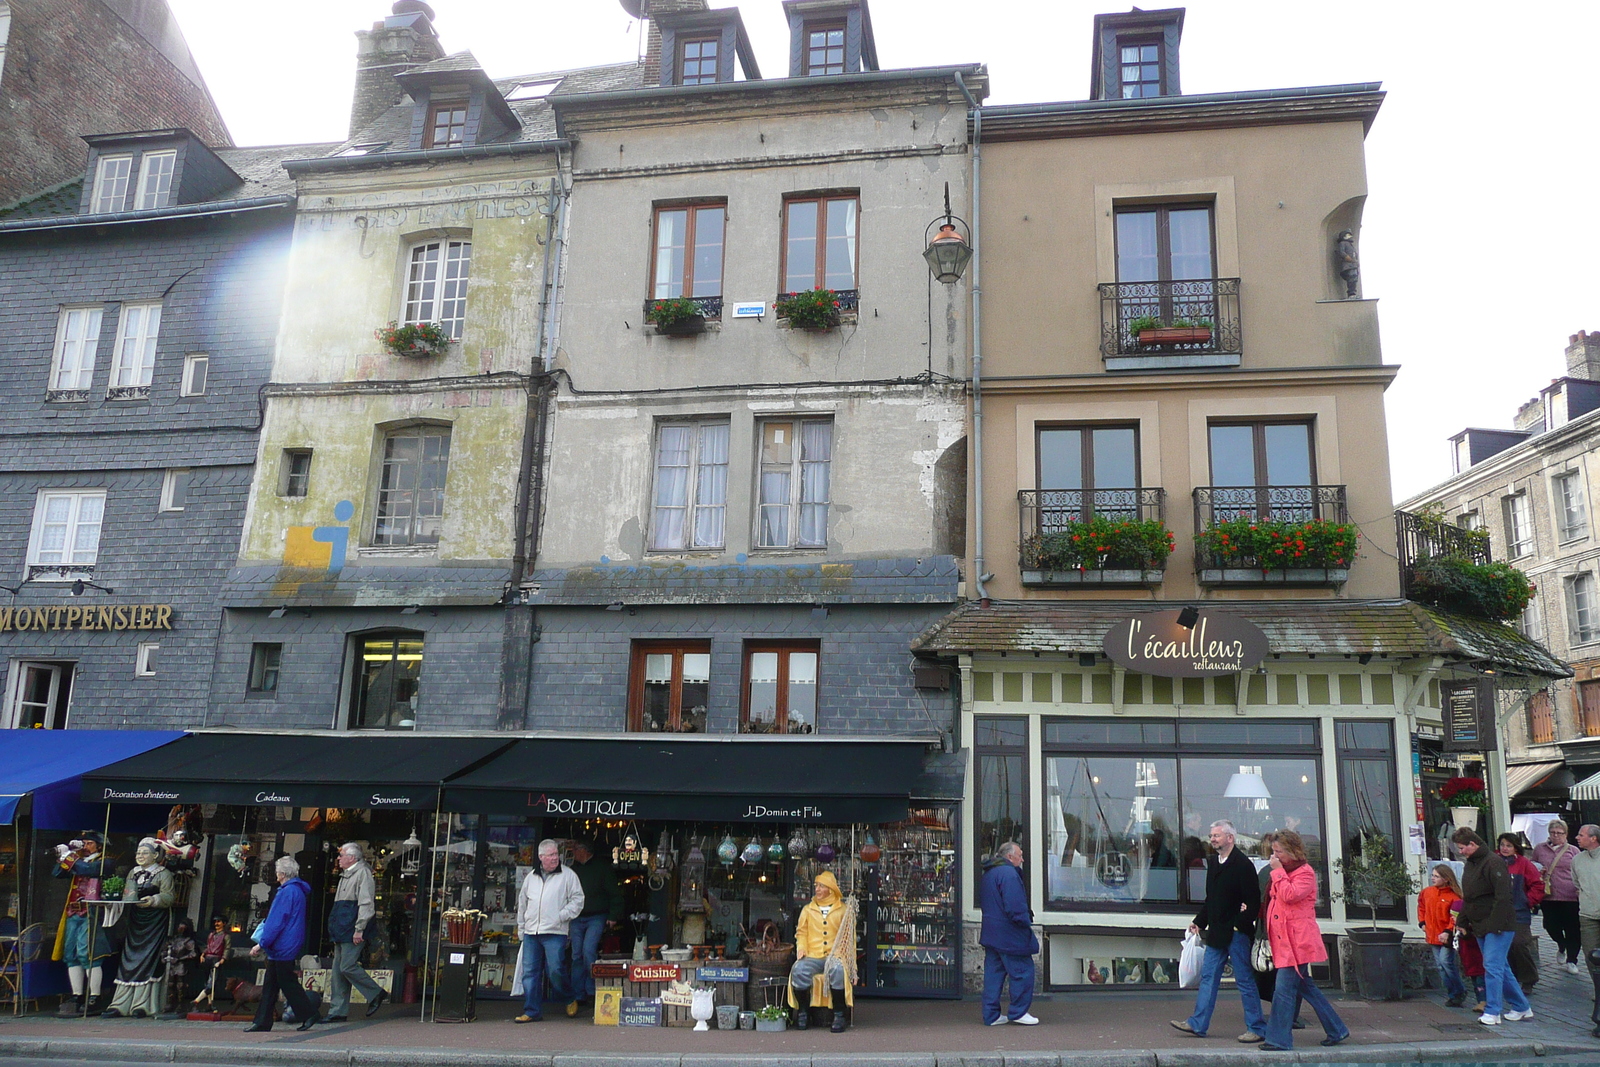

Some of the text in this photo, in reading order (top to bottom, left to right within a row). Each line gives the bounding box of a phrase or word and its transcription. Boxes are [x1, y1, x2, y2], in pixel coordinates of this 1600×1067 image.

[0, 604, 172, 633] MONTPENSIER
[1193, 658, 1242, 671] restaurant
[103, 787, 180, 799] Décoration d'intérieur
[255, 791, 290, 803] Cadeaux
[370, 793, 410, 805] Souvenirs
[527, 792, 636, 816] LA BOUTIQUE
[790, 808, 801, 817] et
[803, 806, 822, 819] Fils
[620, 851, 640, 862] OPEN
[633, 967, 677, 978] Cuisine
[625, 1015, 656, 1024] CUISINE
